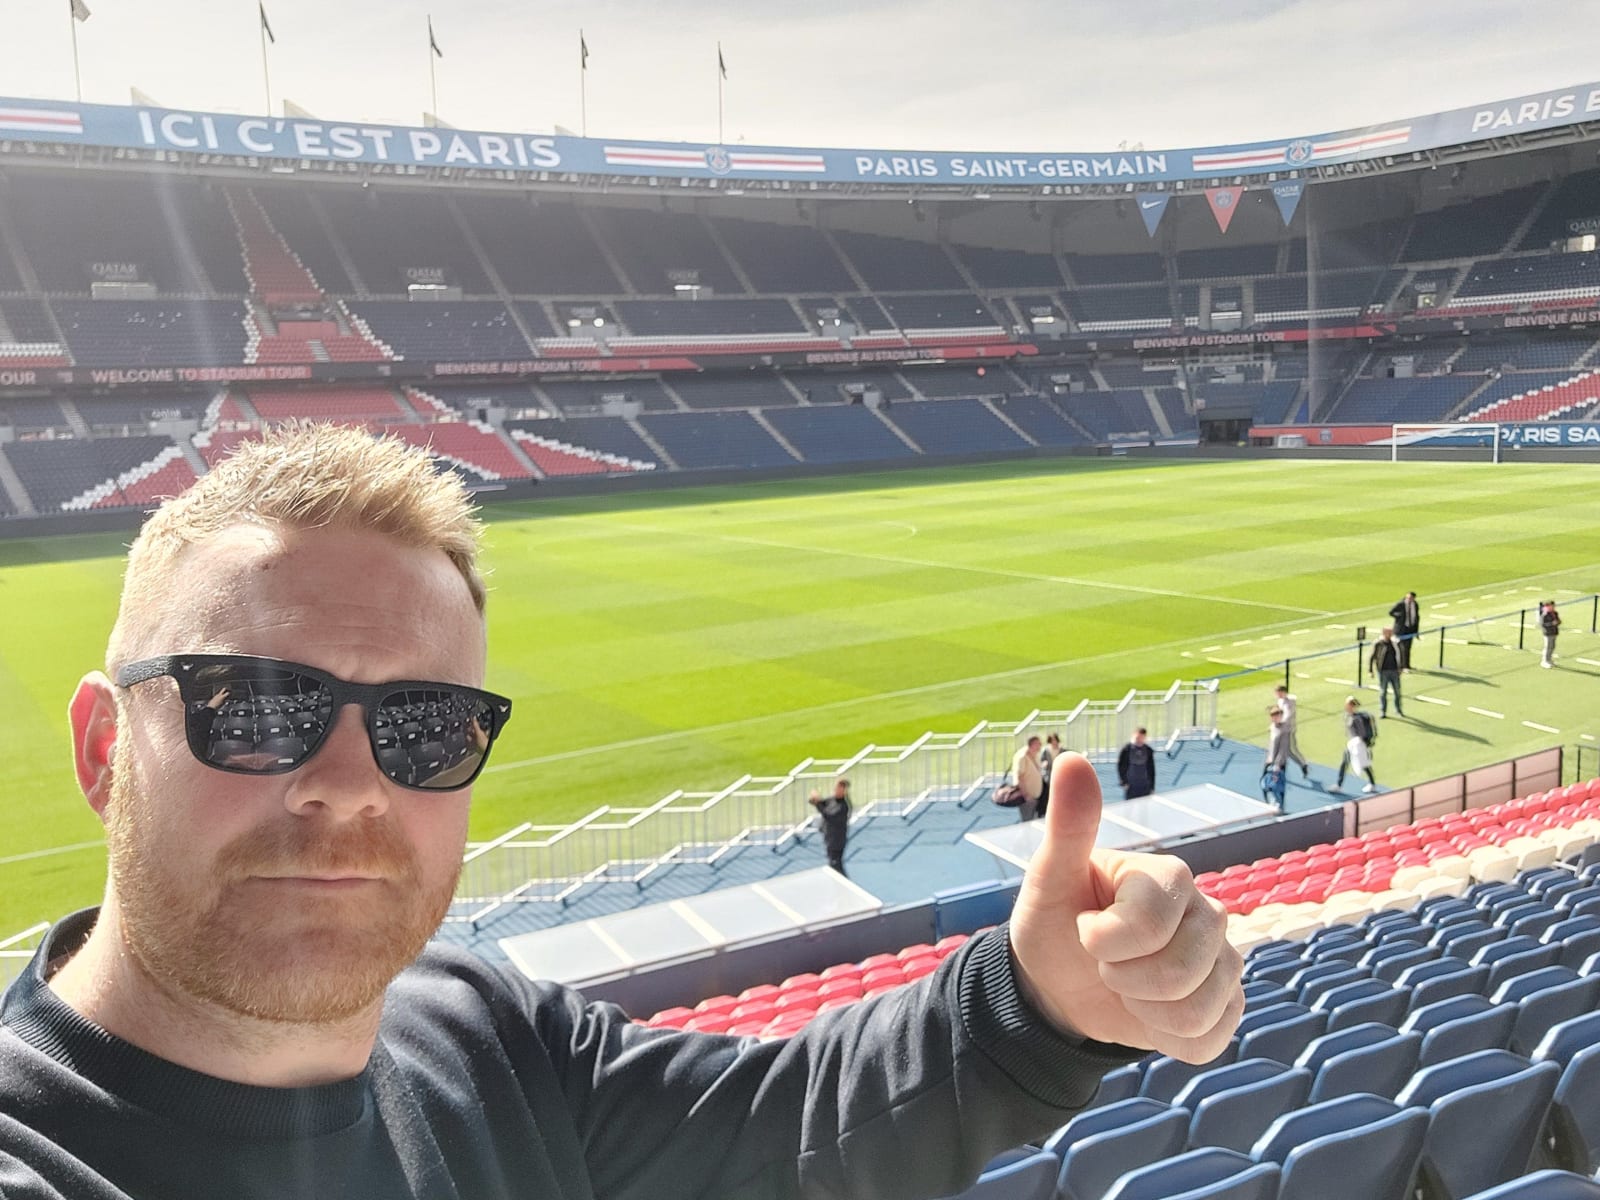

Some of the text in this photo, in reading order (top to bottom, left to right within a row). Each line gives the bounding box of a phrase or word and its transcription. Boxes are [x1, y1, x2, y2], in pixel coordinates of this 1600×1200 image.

[1472, 95, 1576, 133] PARIS
[138, 111, 561, 168] ICI C'EST PARIS
[855, 154, 1167, 177] PARIS SAINT-GERMAIN
[1504, 313, 1568, 327] BIENVENUE
[1570, 311, 1587, 322] AU
[1133, 331, 1284, 349] BIENVENUE AU STADIUM TOUR
[91, 369, 174, 384] WELCOME
[176, 368, 197, 381] TO
